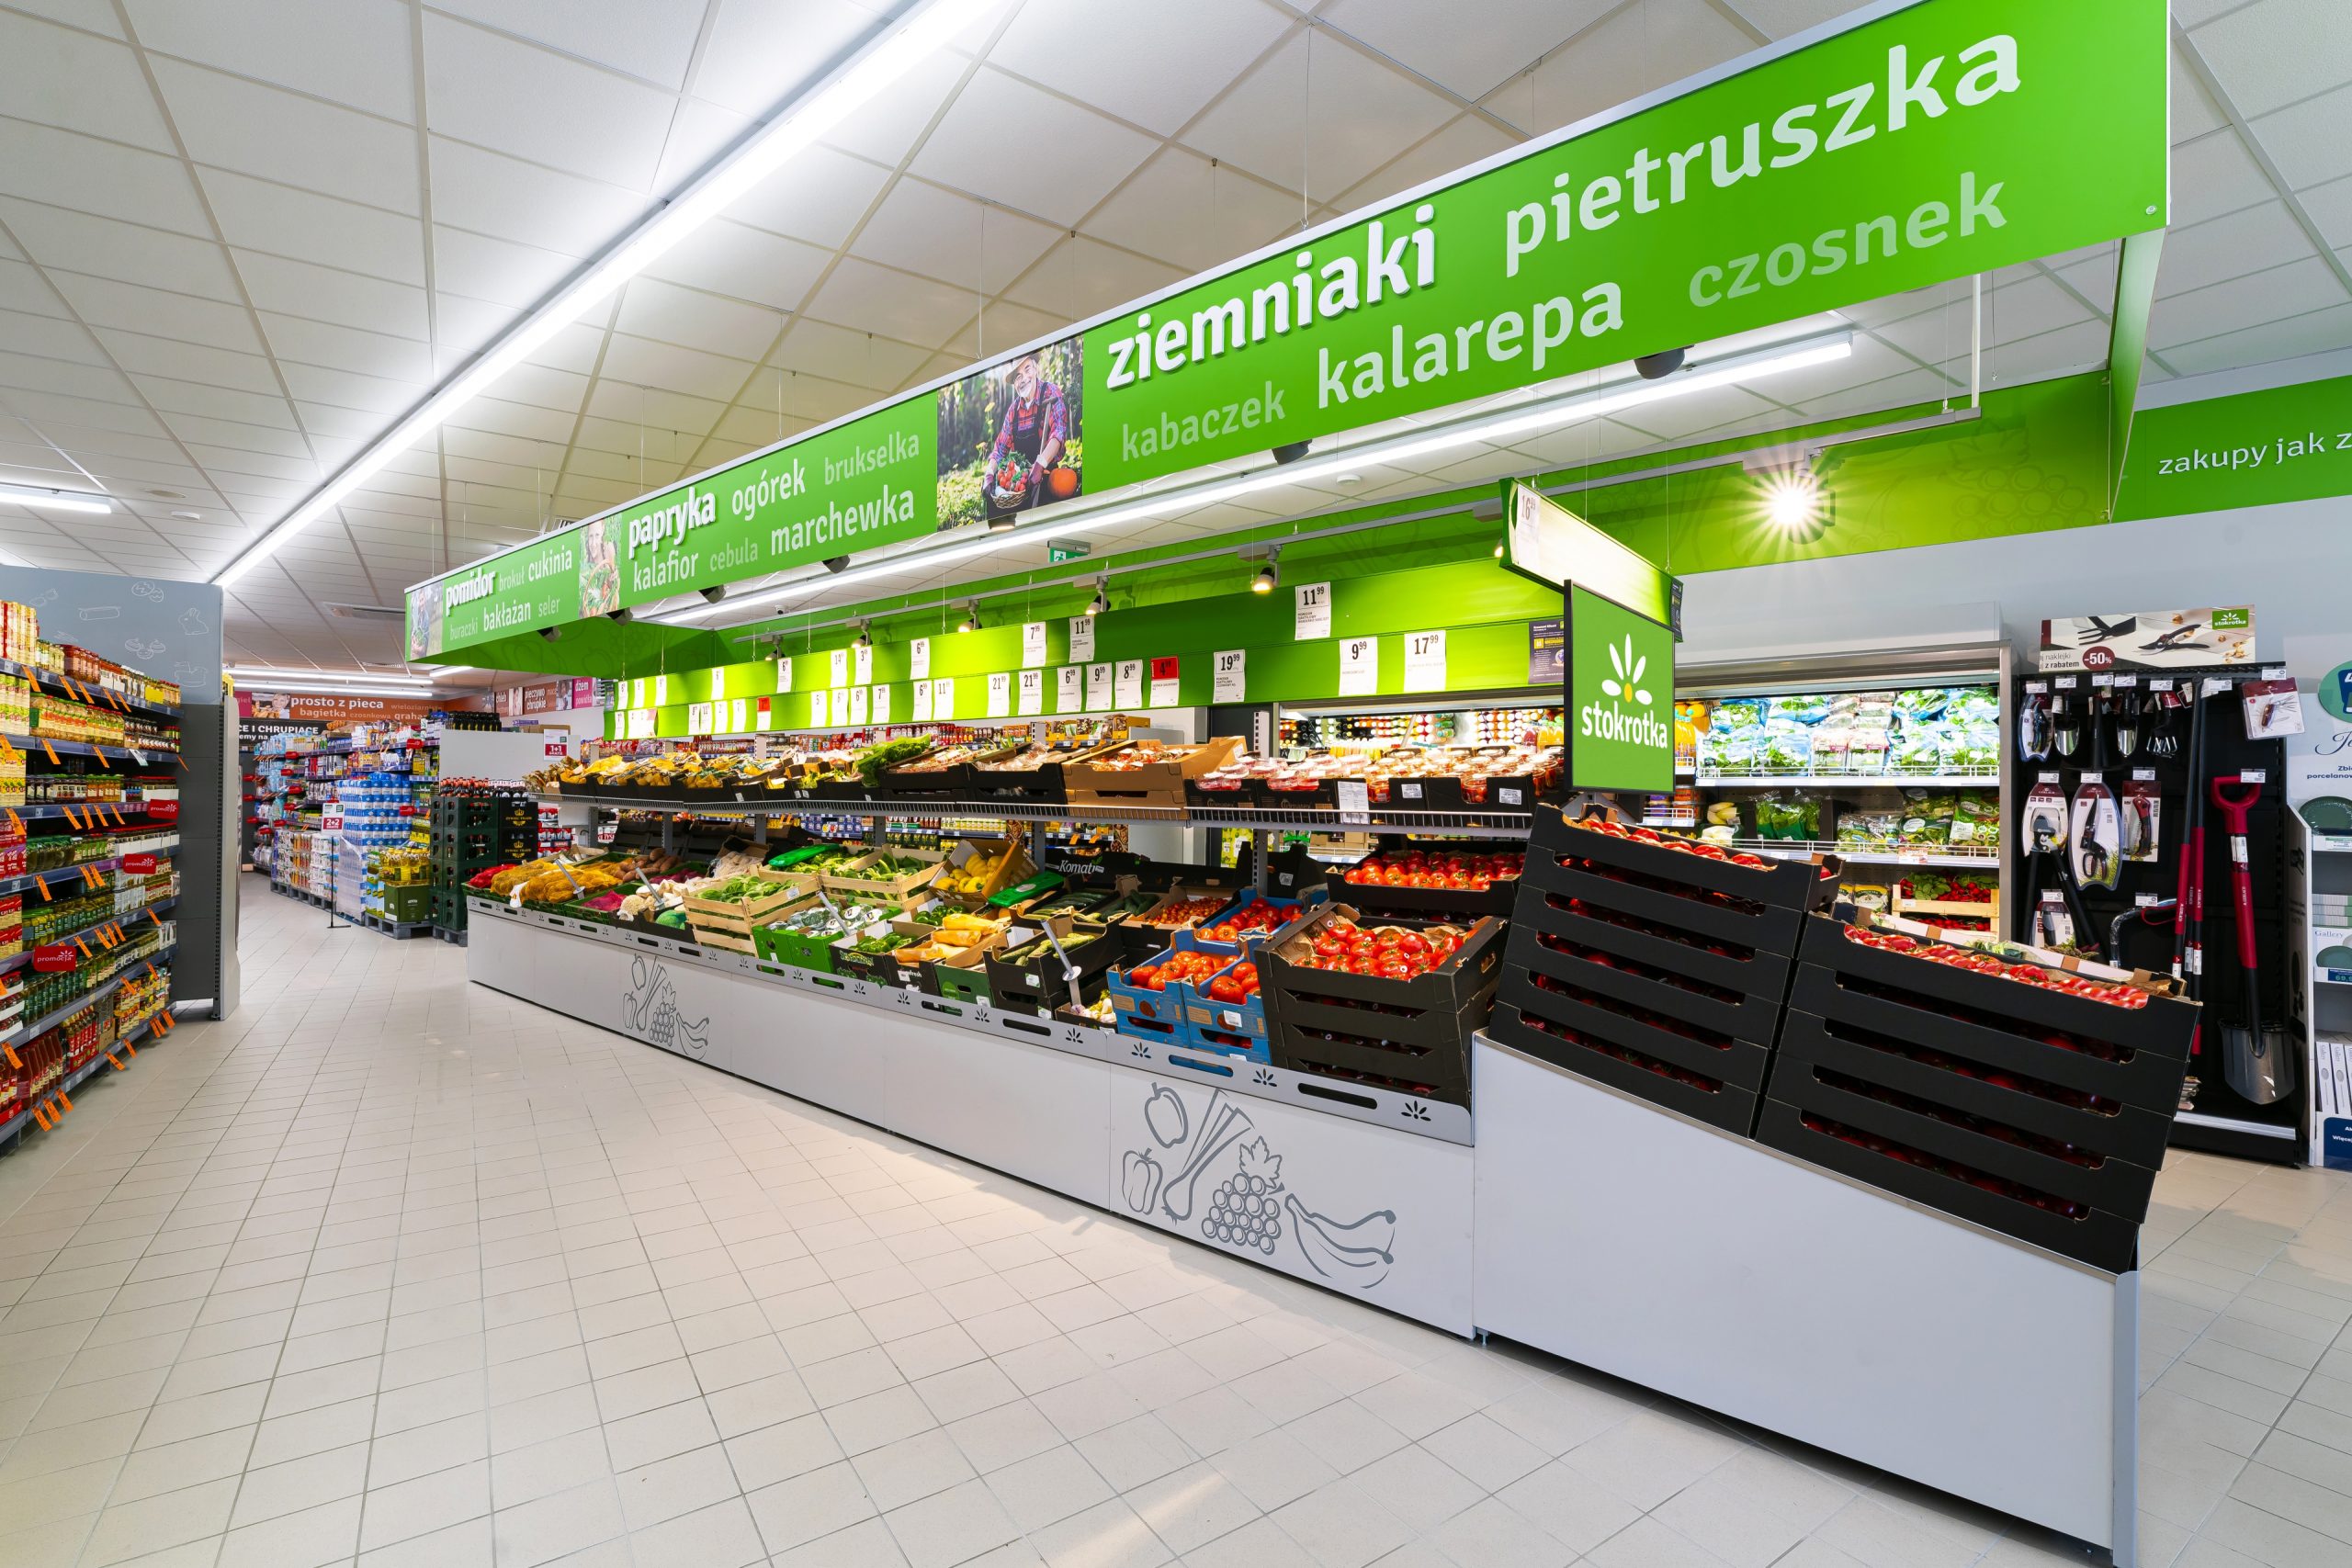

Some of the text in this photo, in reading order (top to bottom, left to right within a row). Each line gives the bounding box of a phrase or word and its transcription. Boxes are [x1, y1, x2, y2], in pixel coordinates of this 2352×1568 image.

[1507, 32, 2021, 279] pietruszka
[1688, 171, 2008, 310] czosnek
[1107, 204, 1437, 392] ziemniaki
[1122, 279, 1624, 464] kabaczek kalarepa
[2159, 445, 2267, 475] zakupy
[2275, 432, 2326, 465] jak
[628, 431, 921, 559] papryka ogórek brukselka
[633, 484, 915, 592] kalafior cebula marchewka
[445, 547, 572, 617] pomidor brokuł cukinia
[449, 595, 560, 641] buraczki bakłażan seler
[2214, 618, 2246, 626] stokrotka
[2045, 652, 2071, 661] naklejki
[2084, 652, 2112, 666] -50%
[2051, 660, 2079, 669] rabatem
[575, 680, 589, 692] dżem
[525, 688, 545, 702] pieczywo
[290, 696, 384, 709] prosto z pieca
[300, 707, 346, 718] bagietka
[394, 712, 426, 721] graha
[1581, 701, 1668, 749] stokrotka
[125, 860, 153, 868] promocja
[2314, 930, 2344, 938] Gallery
[37, 953, 73, 964] promocja
